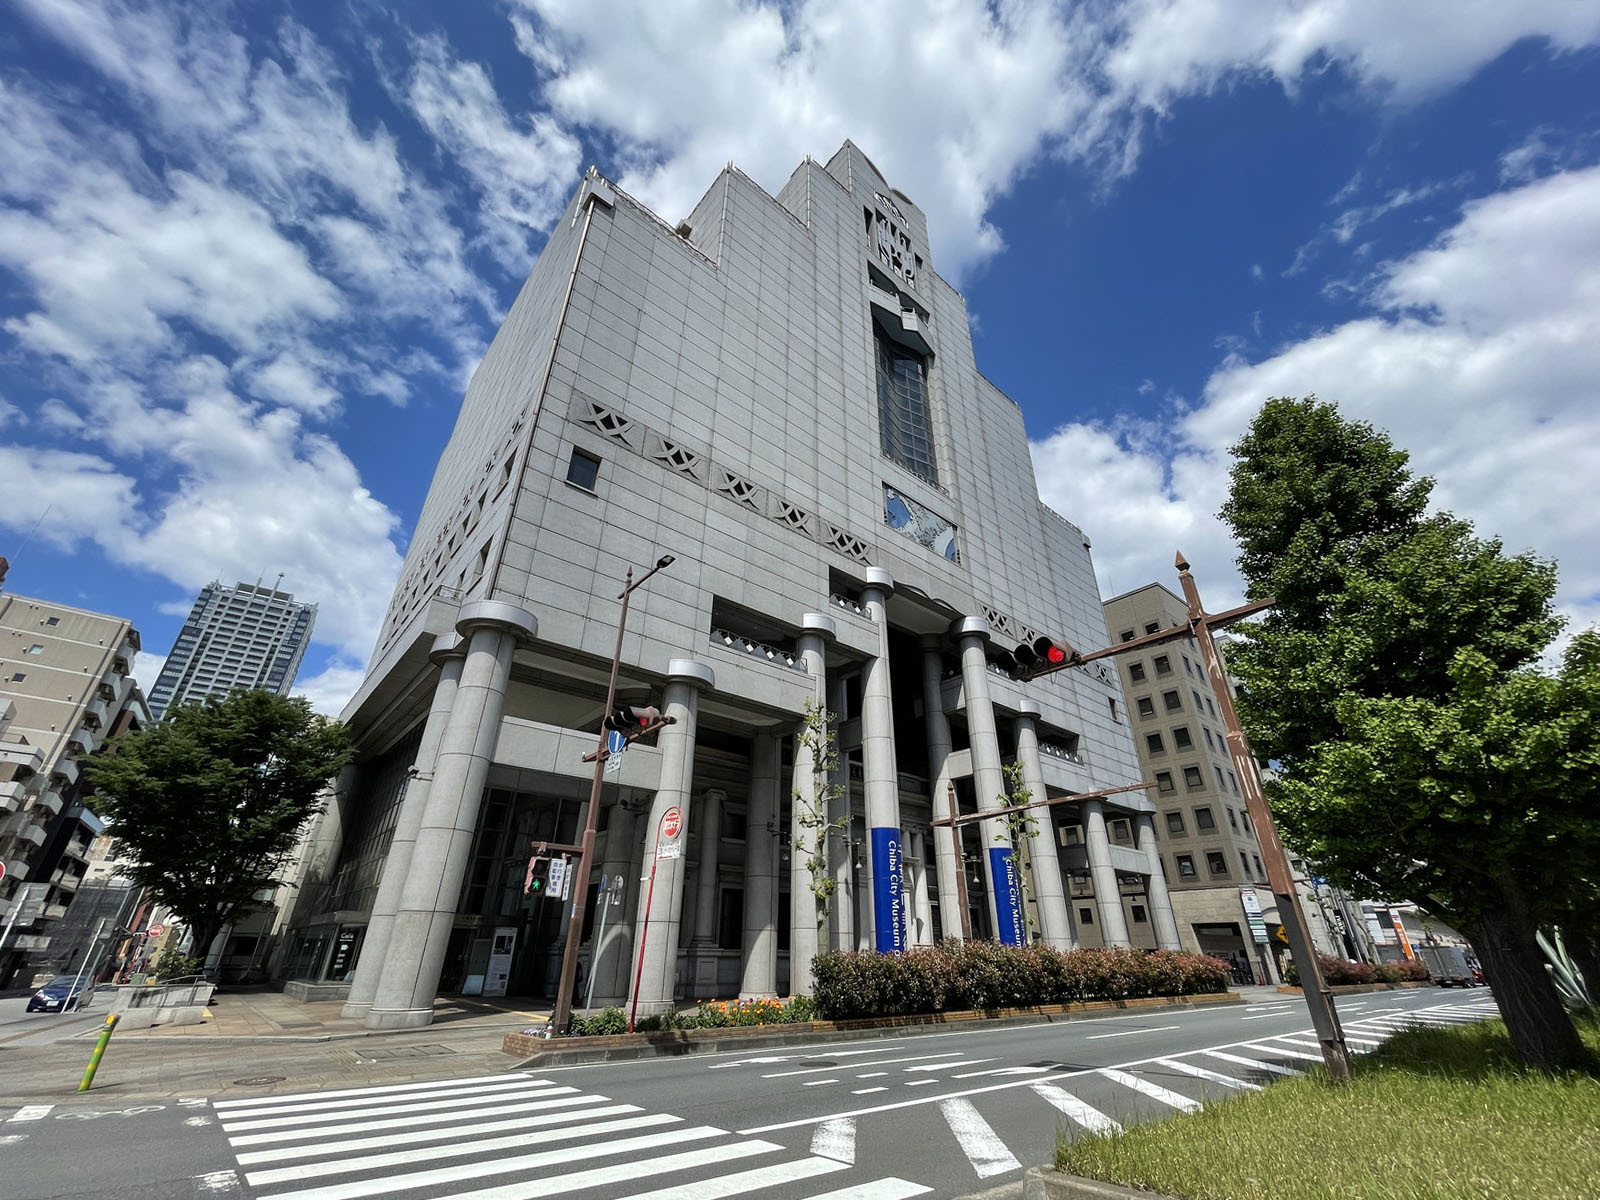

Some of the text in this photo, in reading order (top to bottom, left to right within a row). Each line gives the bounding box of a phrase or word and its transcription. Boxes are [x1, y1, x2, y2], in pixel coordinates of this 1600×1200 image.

[888, 840, 898, 871] Chiba
[1005, 859, 1014, 885] Chiba
[888, 875, 899, 897] City
[1009, 889, 1017, 907] City
[891, 899, 901, 947] Museum
